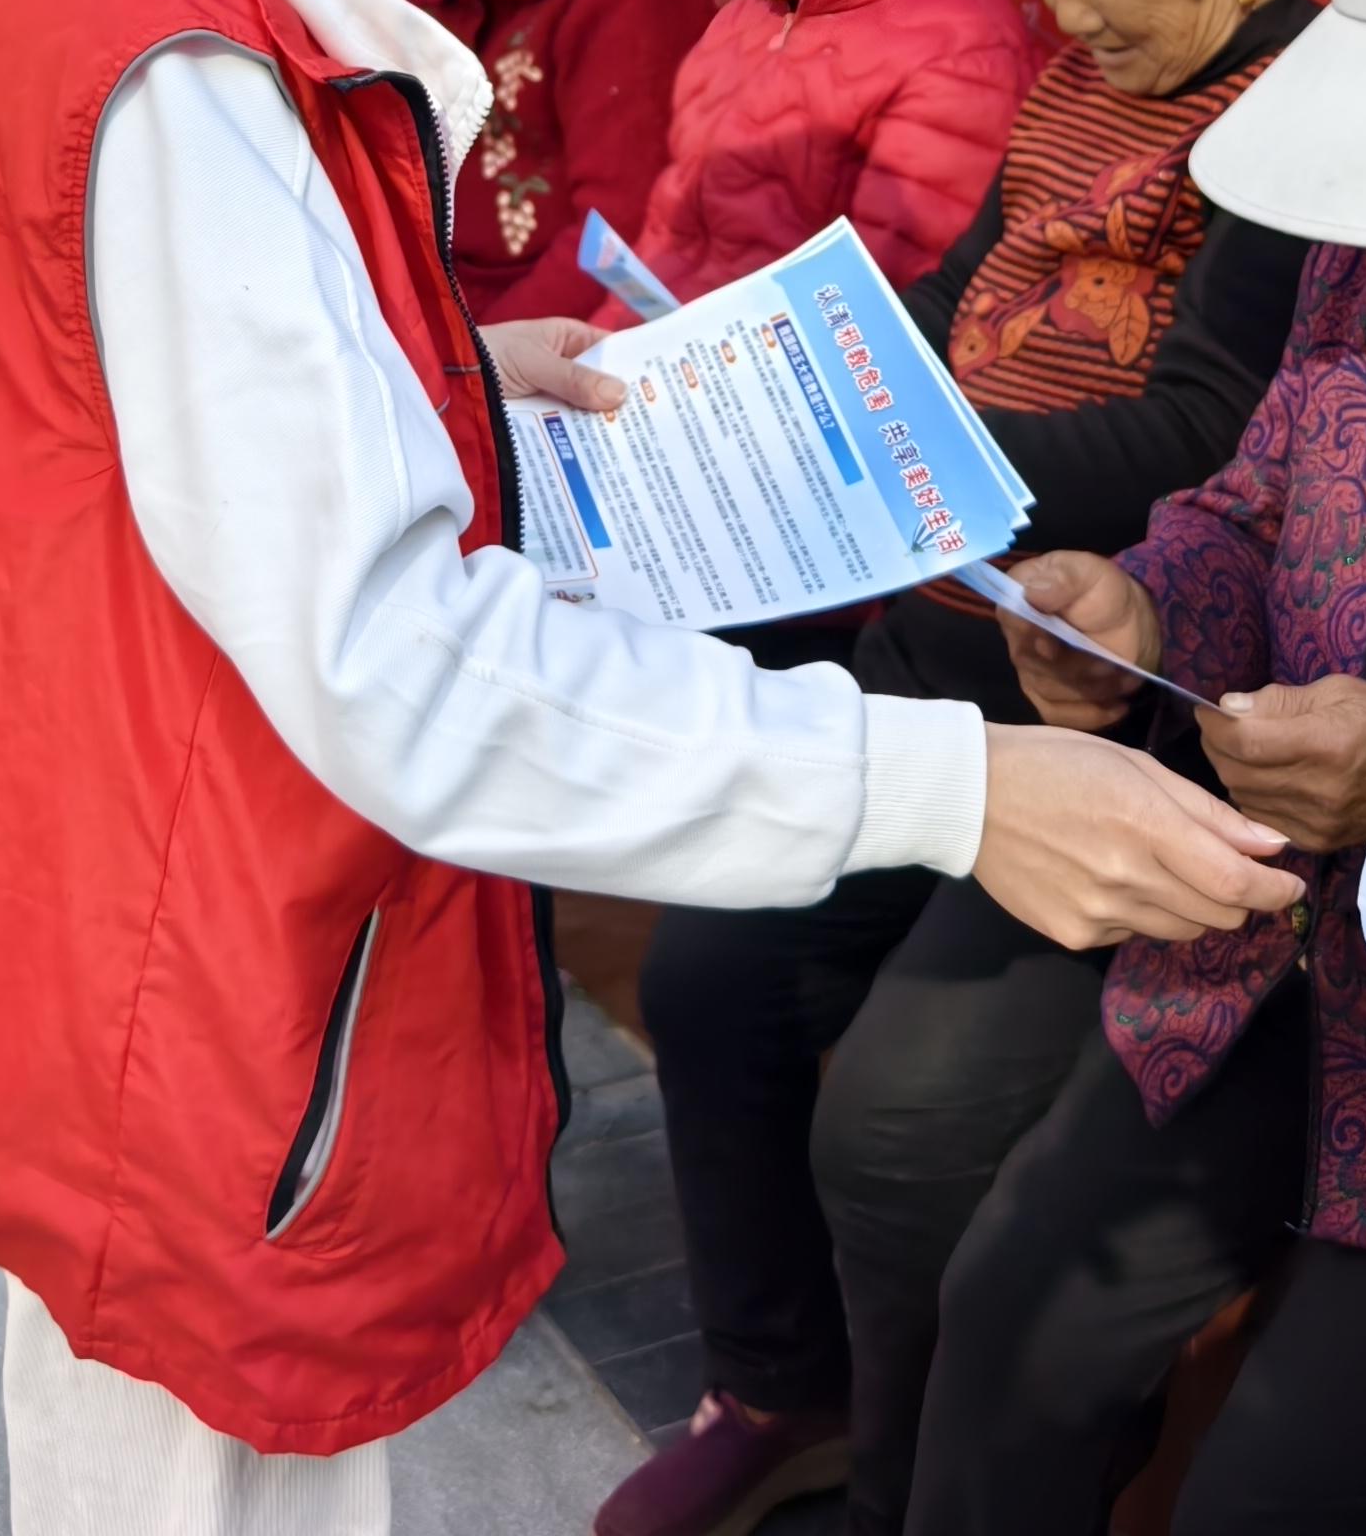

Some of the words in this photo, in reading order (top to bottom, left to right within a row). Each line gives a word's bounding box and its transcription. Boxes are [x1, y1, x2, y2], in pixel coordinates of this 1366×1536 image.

[814, 283, 894, 412] 认清邪教危害
[879, 420, 967, 555] 共享美好生活
